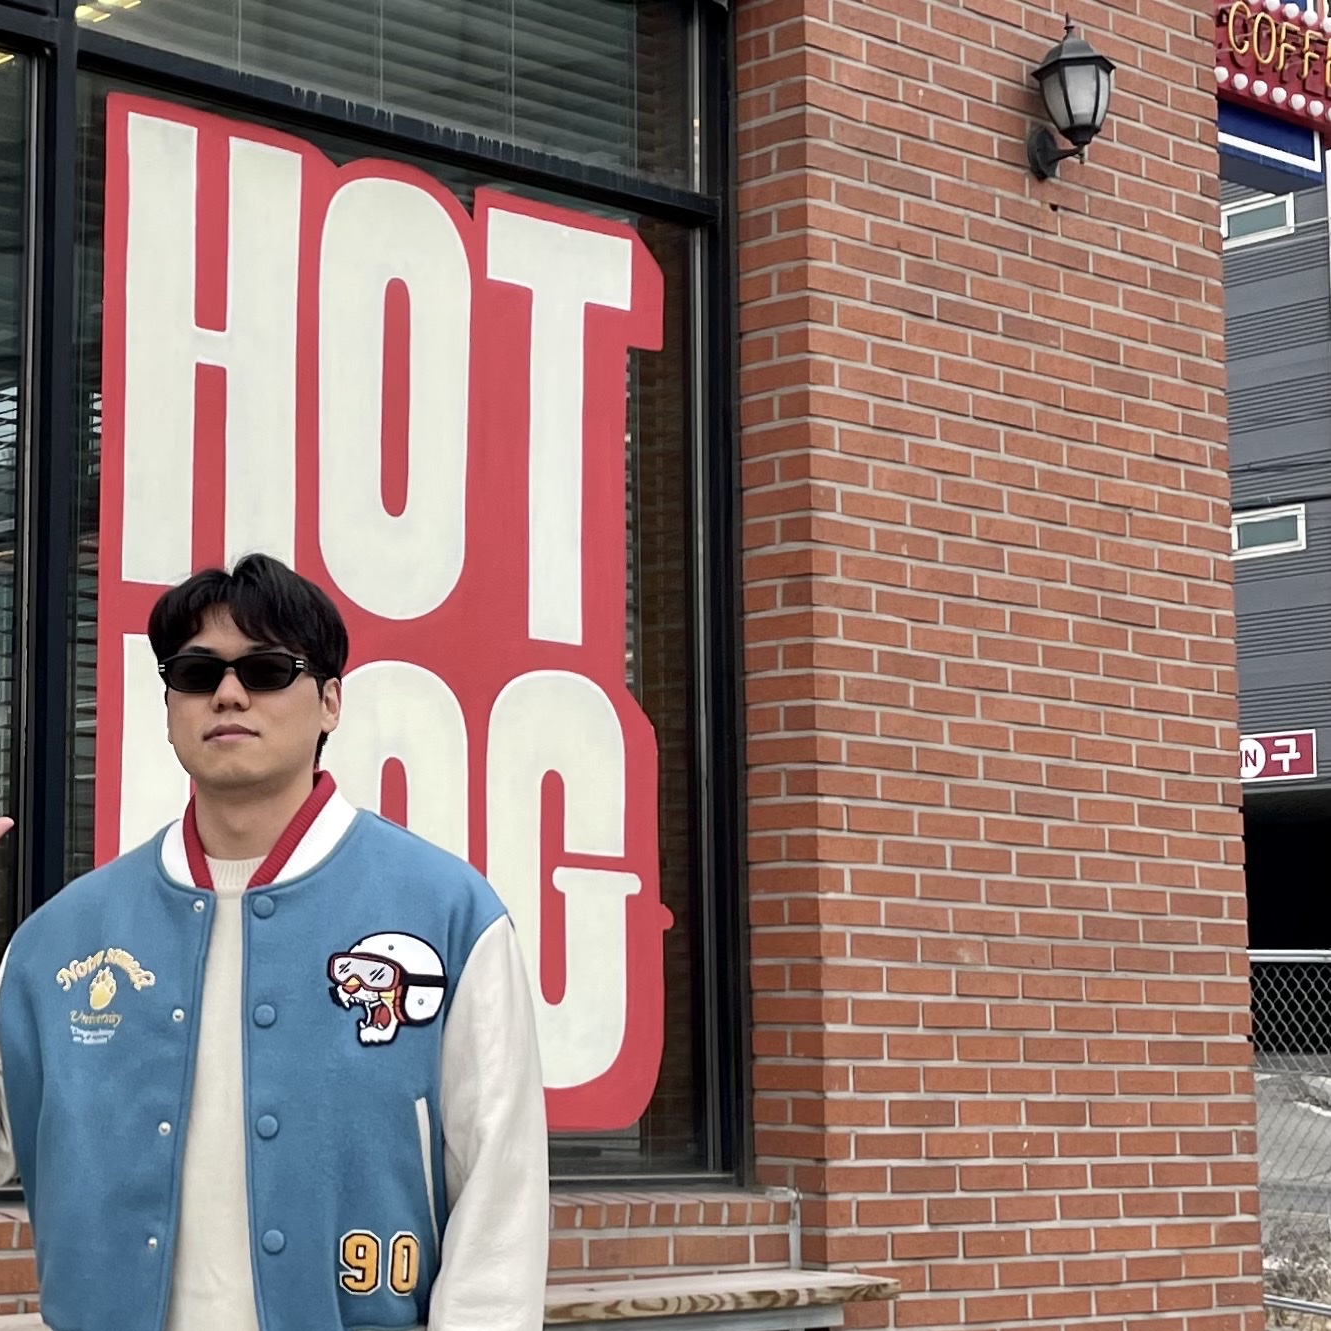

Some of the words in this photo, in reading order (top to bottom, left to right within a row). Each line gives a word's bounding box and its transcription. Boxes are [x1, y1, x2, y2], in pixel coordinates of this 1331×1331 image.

[1228, 1, 1331, 89] COFF
[122, 111, 632, 646] HOT
[1270, 738, 1302, 773] 구
[339, 1229, 420, 1297] 90
